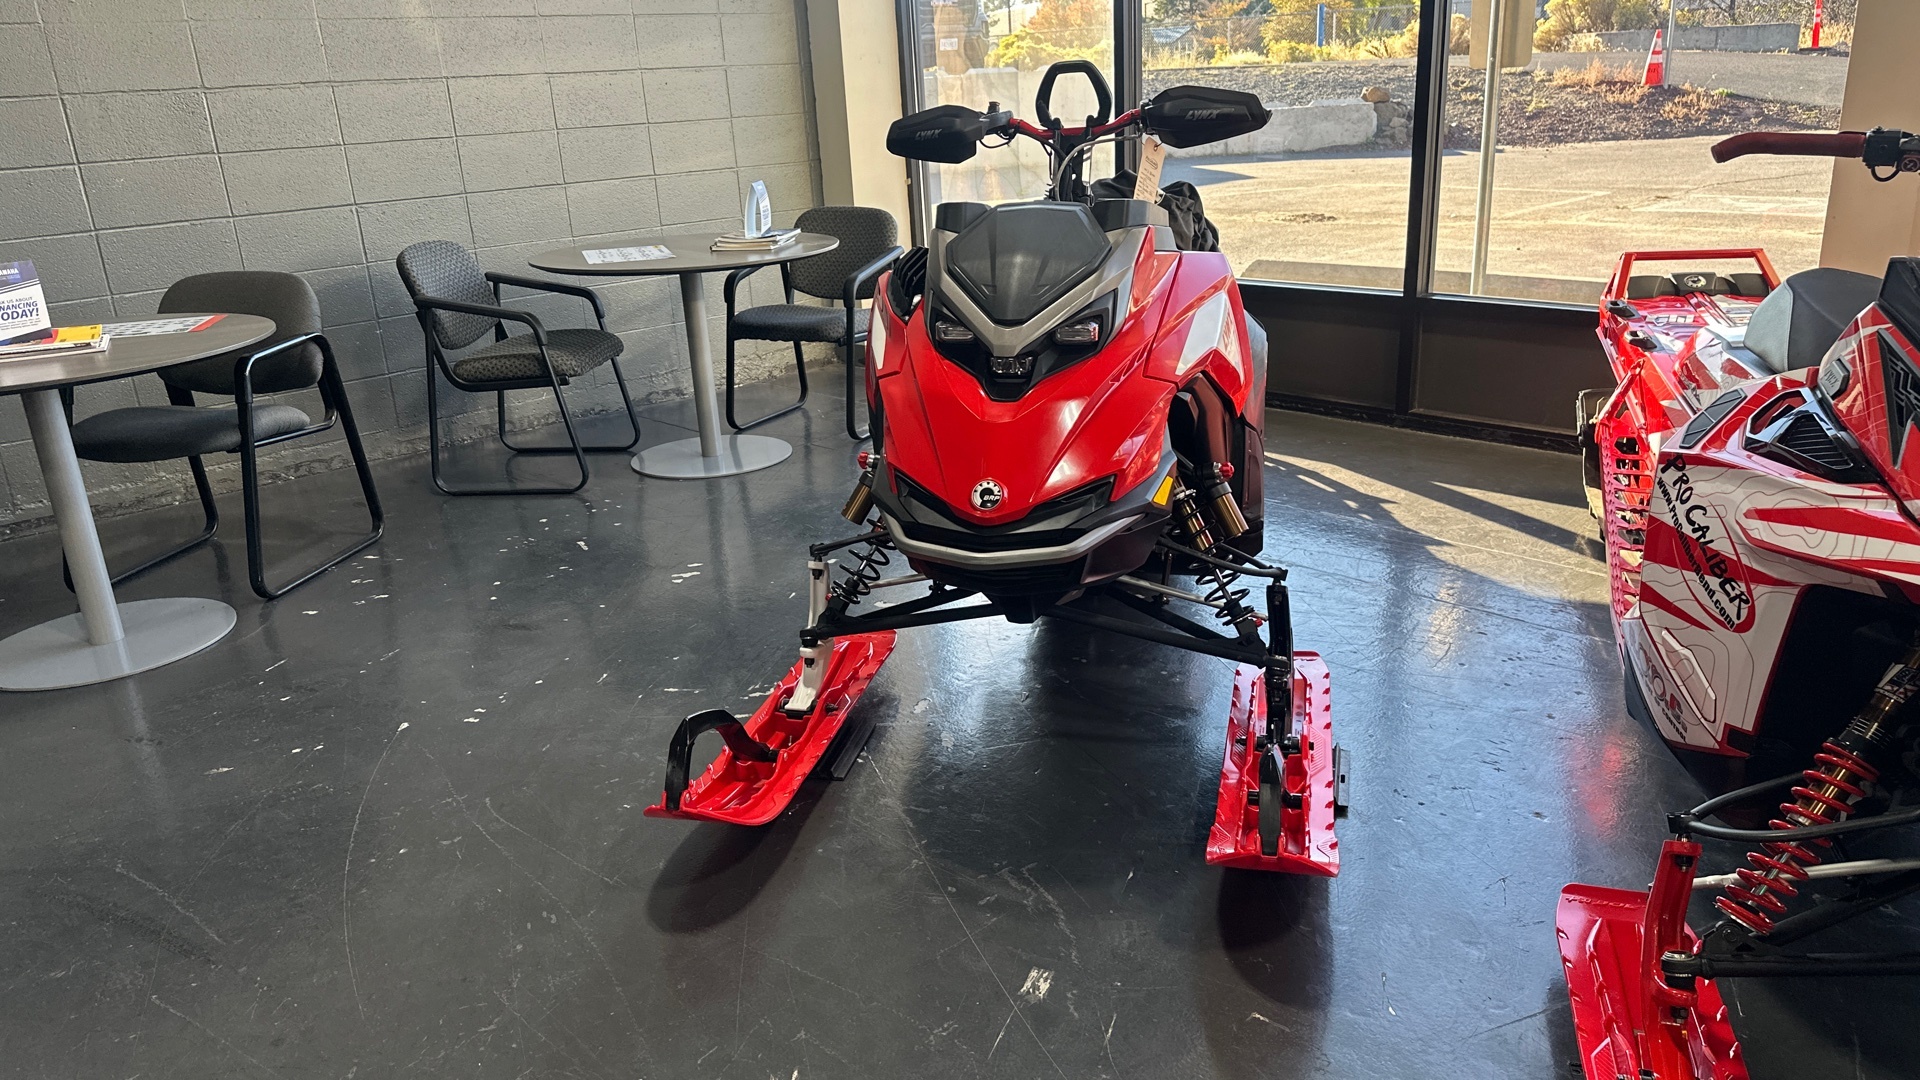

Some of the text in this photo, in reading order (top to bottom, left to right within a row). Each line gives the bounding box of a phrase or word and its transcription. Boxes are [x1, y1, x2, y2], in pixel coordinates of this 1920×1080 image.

[1185, 109, 1220, 120] LYNX
[915, 129, 942, 140] LYNX
[1, 307, 39, 321] ODAY!
[1660, 455, 1751, 621] PRO CALIBER
[1661, 707, 1688, 744] CONTROL
